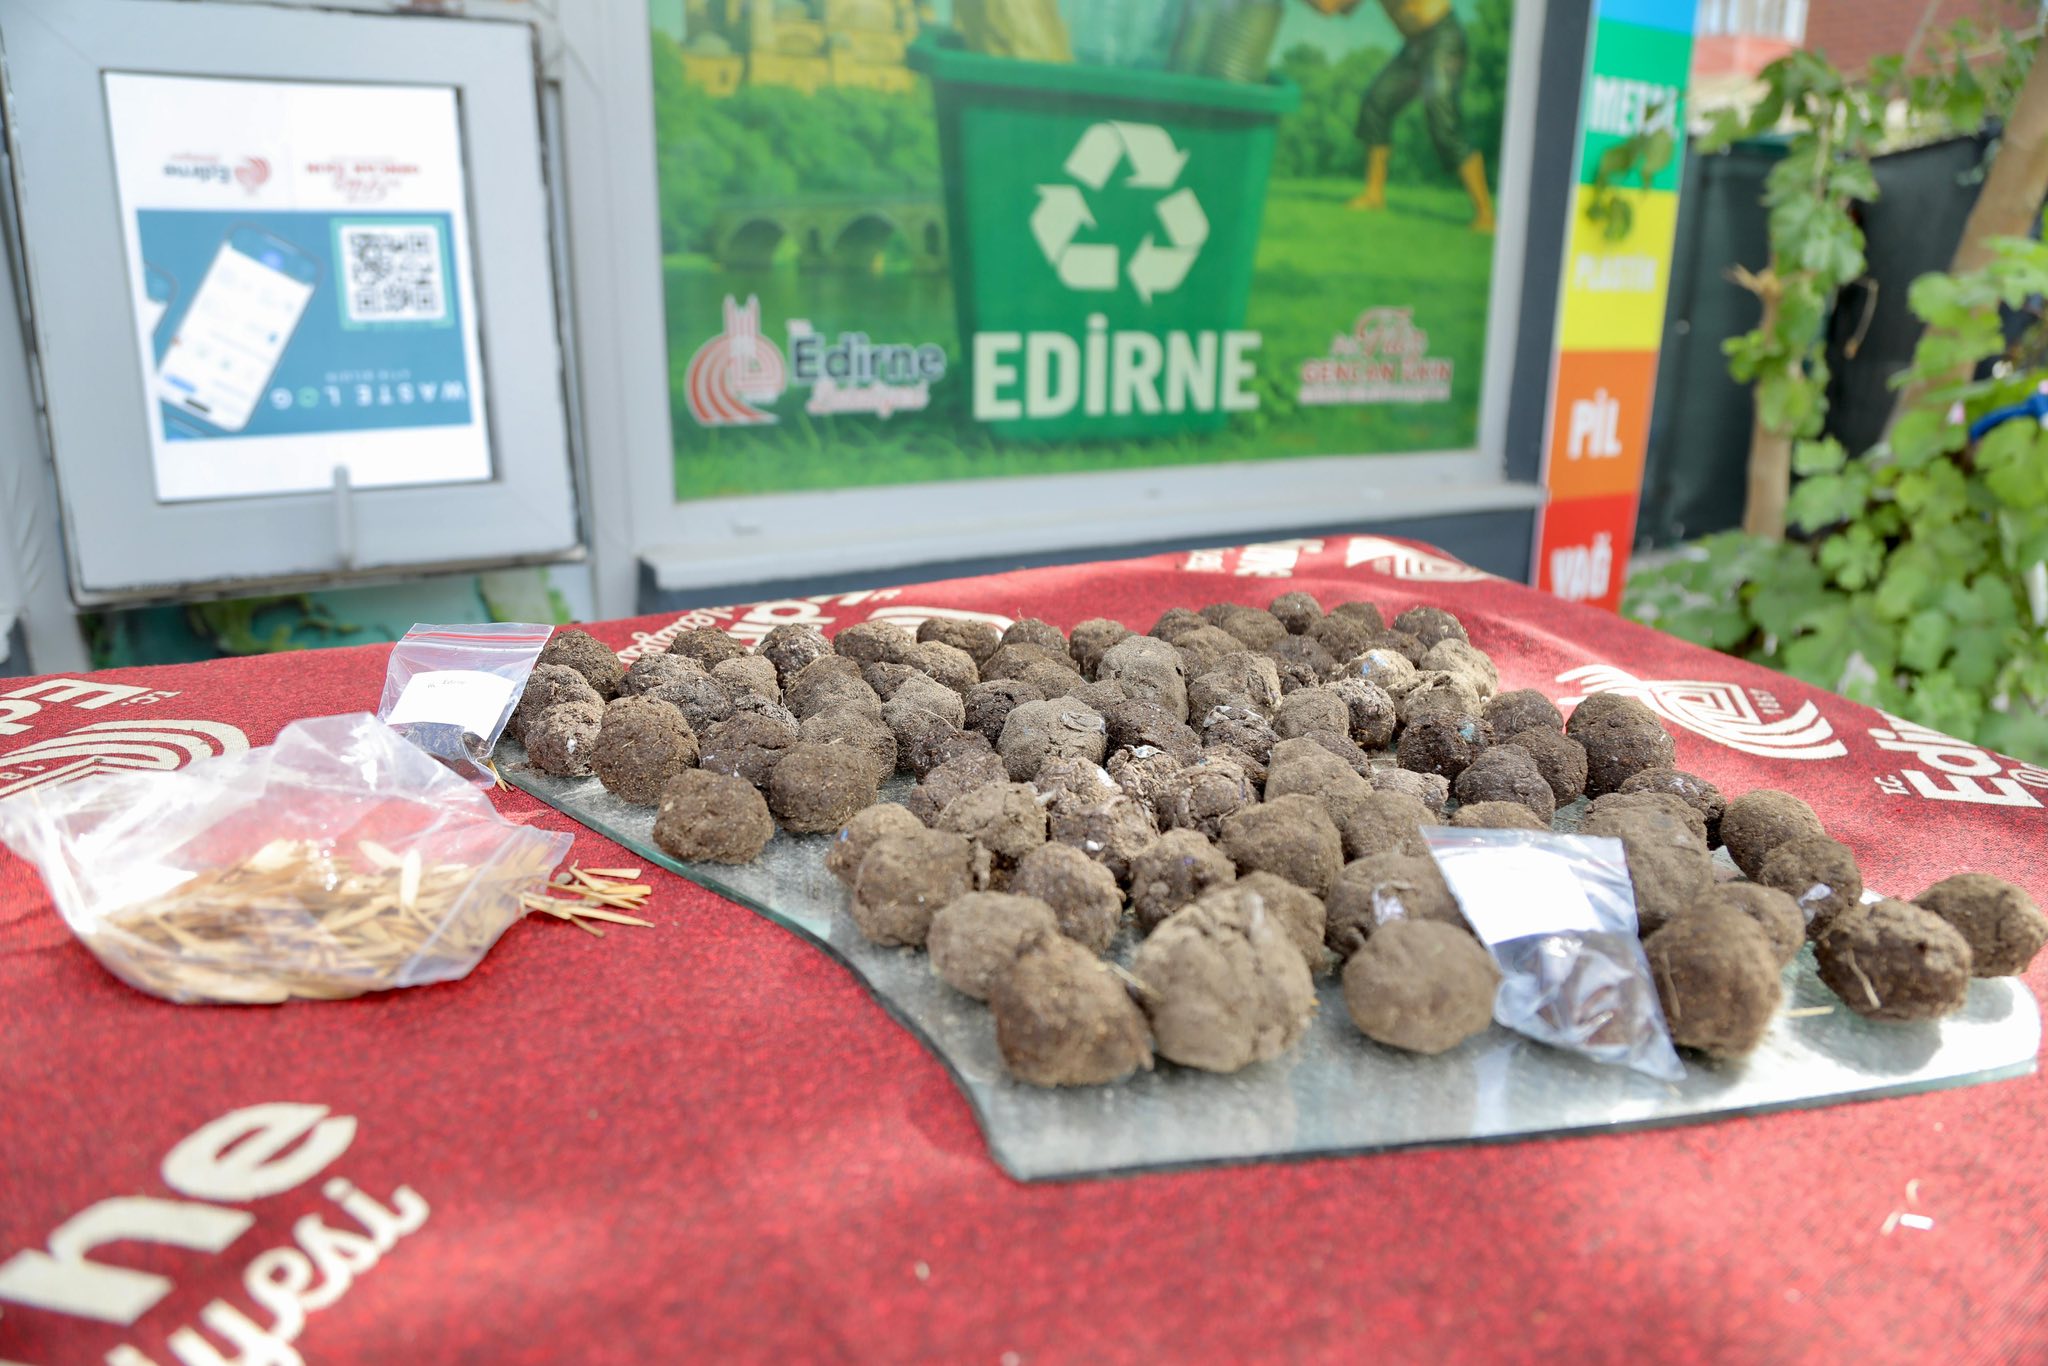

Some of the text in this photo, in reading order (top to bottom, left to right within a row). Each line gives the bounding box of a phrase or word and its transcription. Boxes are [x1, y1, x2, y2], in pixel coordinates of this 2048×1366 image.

[792, 332, 946, 381] Edirne
[973, 312, 1262, 421] EDİRNE
[269, 380, 467, 410] WASTE LOG
[1567, 387, 1623, 460] PİL
